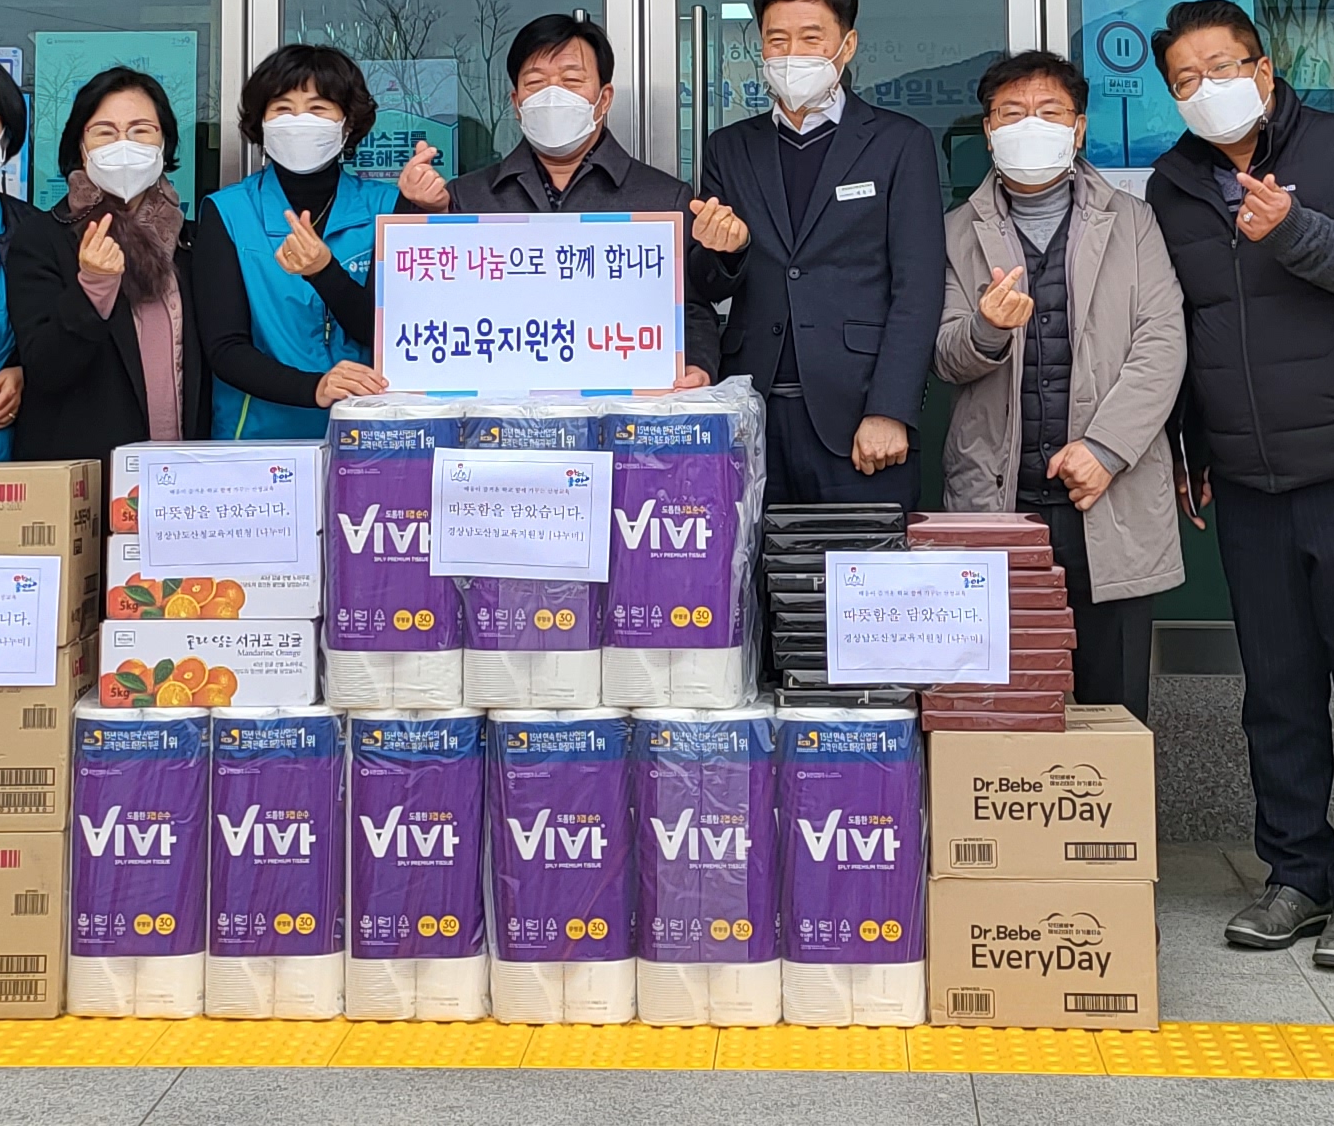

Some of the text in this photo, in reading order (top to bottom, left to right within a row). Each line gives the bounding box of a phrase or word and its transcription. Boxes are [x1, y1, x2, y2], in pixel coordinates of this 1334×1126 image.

[396, 244, 665, 281] 따뜻한 나눔으로 함께 합니다
[395, 317, 663, 363] 산청교육지원청 나누미
[155, 502, 290, 521] 따뜻함을 담았습니다.
[449, 502, 585, 521] 따뜻함을 담았습니다.
[119, 599, 139, 612] 5kg
[418, 614, 432, 622] 30
[559, 613, 573, 622] 30
[695, 610, 709, 619] 30
[844, 607, 983, 623] 따뜻함을 담았습니다.
[236, 633, 273, 648] 서귀포
[277, 632, 303, 648] 감귤
[237, 649, 301, 658] Mandarine Orange
[110, 687, 130, 700] 5kg
[973, 778, 1043, 793] Dr.Bebe
[974, 795, 1112, 828] EveryDay
[158, 917, 172, 927] 30
[299, 917, 312, 927] 30
[443, 919, 456, 929] 30
[590, 922, 604, 932] 30
[735, 923, 749, 933] 30
[885, 924, 899, 934] 30
[971, 925, 1041, 941] Dr.Bebe
[971, 943, 1112, 978] EveryDay
